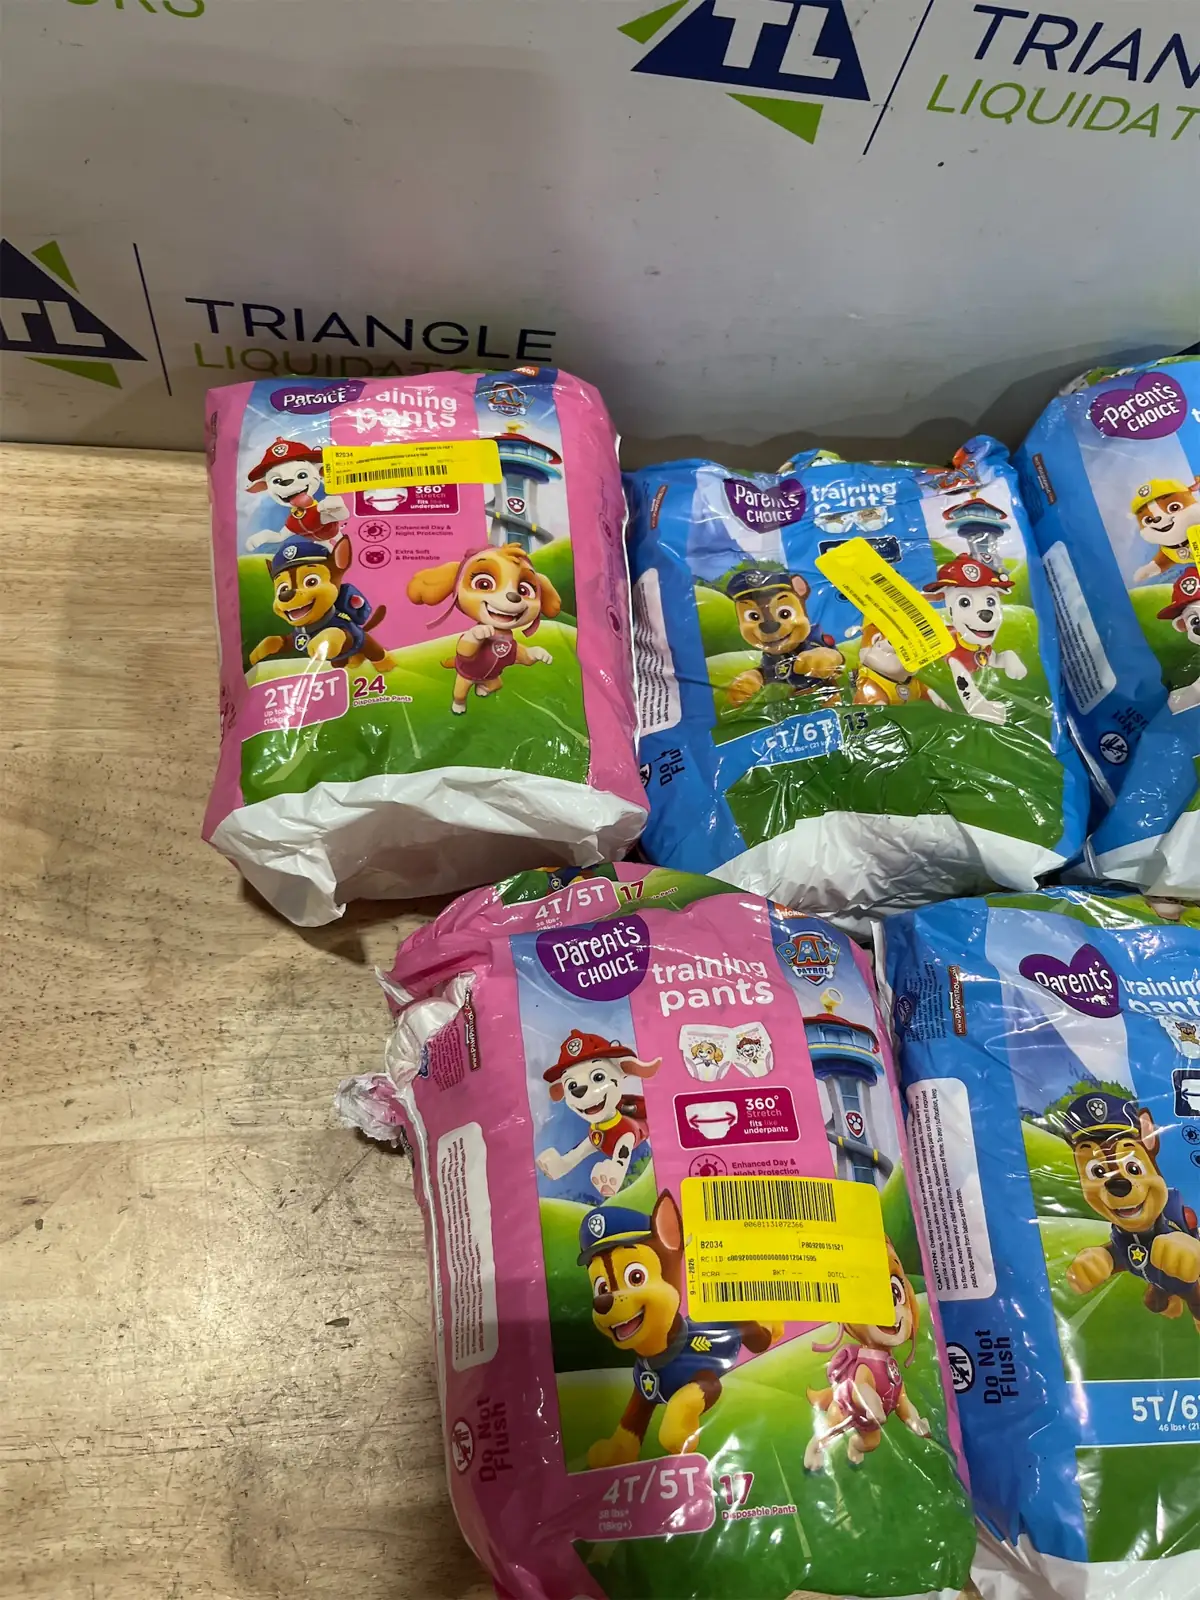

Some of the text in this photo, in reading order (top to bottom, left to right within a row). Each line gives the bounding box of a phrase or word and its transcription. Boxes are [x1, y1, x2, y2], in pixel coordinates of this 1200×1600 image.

[712, 0, 841, 80] TL
[185, 298, 556, 362] TRIANGLE
[194, 343, 464, 377] LIQUIDAT
[374, 387, 457, 413] aining
[1104, 382, 1178, 429] Parent's
[354, 406, 456, 435] pants
[1126, 401, 1180, 432] CHOICE
[811, 480, 896, 502] training
[353, 675, 386, 698] 24
[353, 696, 391, 707] Disposable
[844, 712, 870, 732] 13
[659, 763, 673, 786] Do
[669, 748, 686, 774] Flu
[534, 880, 644, 920] 4T/5T 17
[552, 921, 642, 973] Parent's
[777, 940, 840, 966] PAW
[577, 952, 639, 989] CHOICE
[652, 952, 768, 984] training
[796, 967, 829, 975] PATROL
[1034, 960, 1112, 996] Parent's
[659, 978, 774, 1017] pants
[746, 1108, 782, 1118] Stretch
[744, 1126, 788, 1134] underpants
[732, 1160, 771, 1169] Enhanced
[773, 1159, 788, 1168] Day
[932, 1250, 942, 1290] CAUTION:
[974, 1328, 1002, 1404] Do Not
[998, 1336, 1020, 1397] Flush
[1132, 1390, 1200, 1422] 5T/6
[476, 1396, 497, 1482] Do Not
[492, 1402, 513, 1472] Flush
[1170, 1423, 1186, 1431] lbs+
[602, 1465, 755, 1506] 4T/5T 17
[722, 1504, 797, 1520] Disposable Pants
